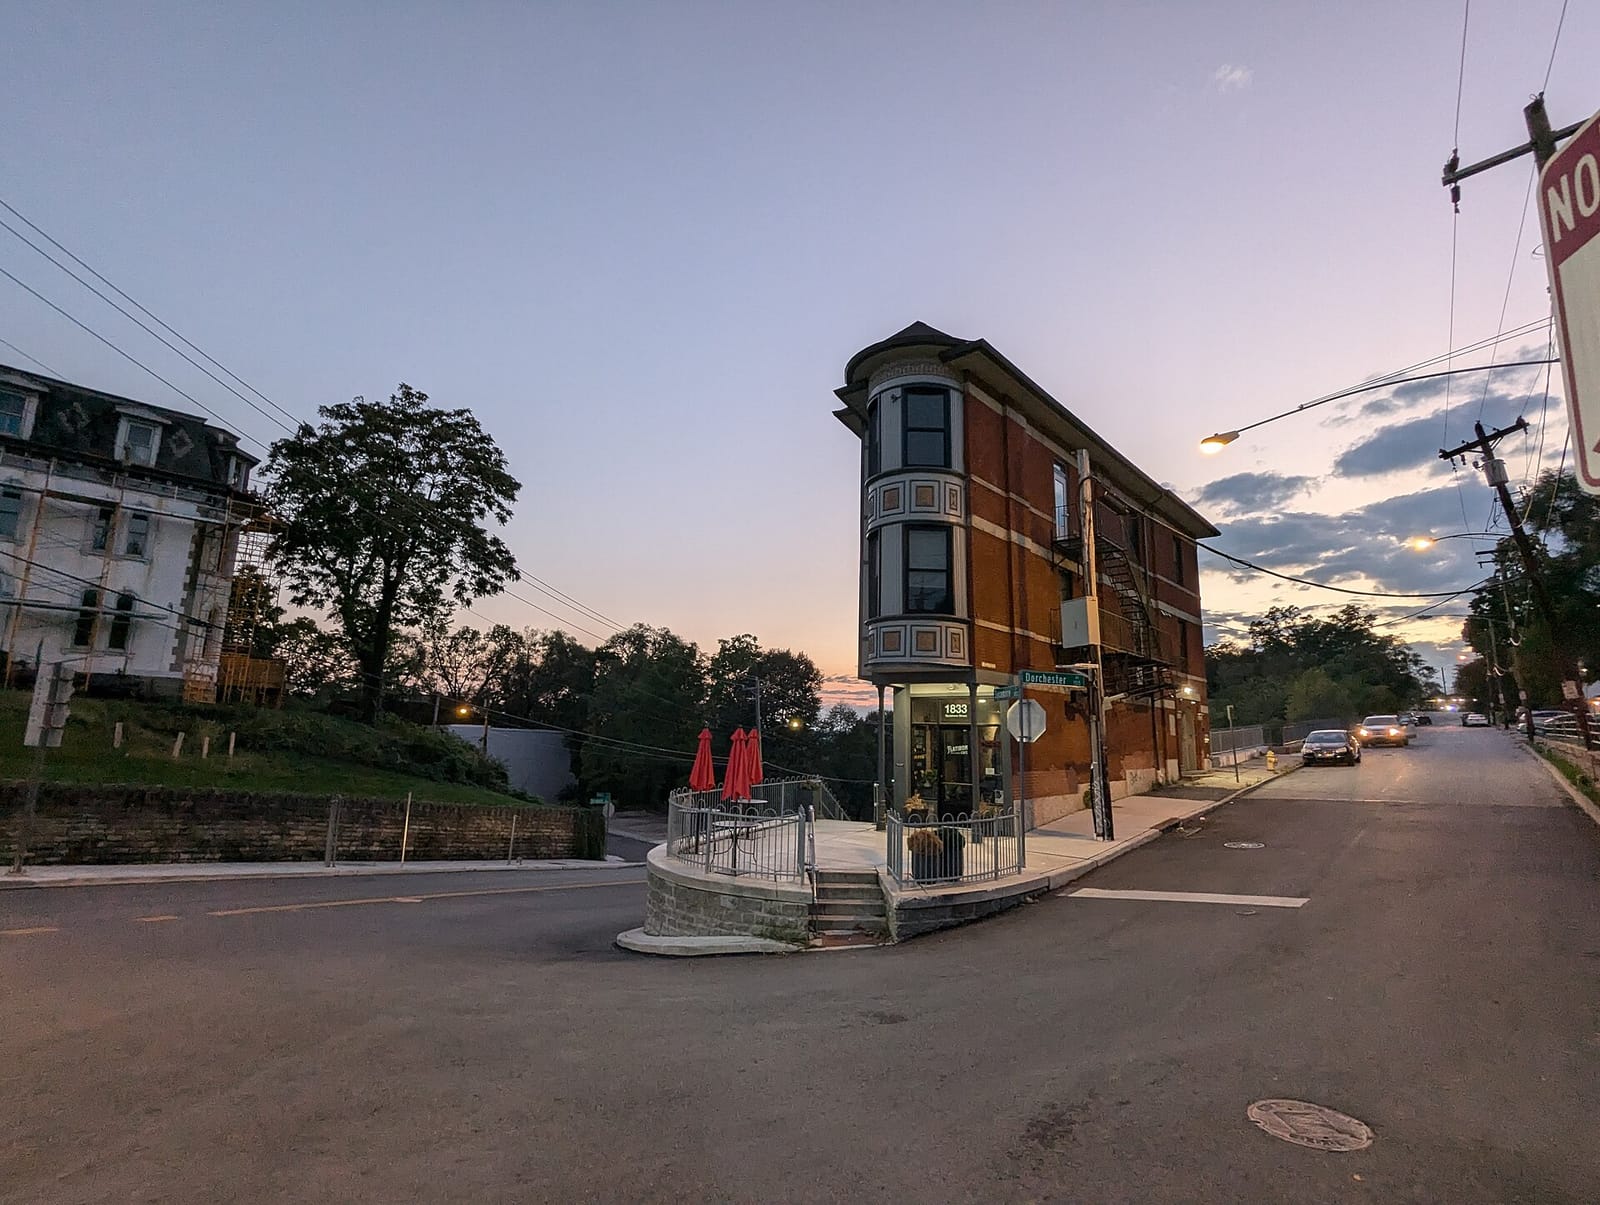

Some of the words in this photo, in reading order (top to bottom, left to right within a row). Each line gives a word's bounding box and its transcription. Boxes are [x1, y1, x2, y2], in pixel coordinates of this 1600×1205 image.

[1547, 153, 1600, 243] NO
[1025, 672, 1067, 685] Dorchester
[944, 704, 968, 714] 1833
